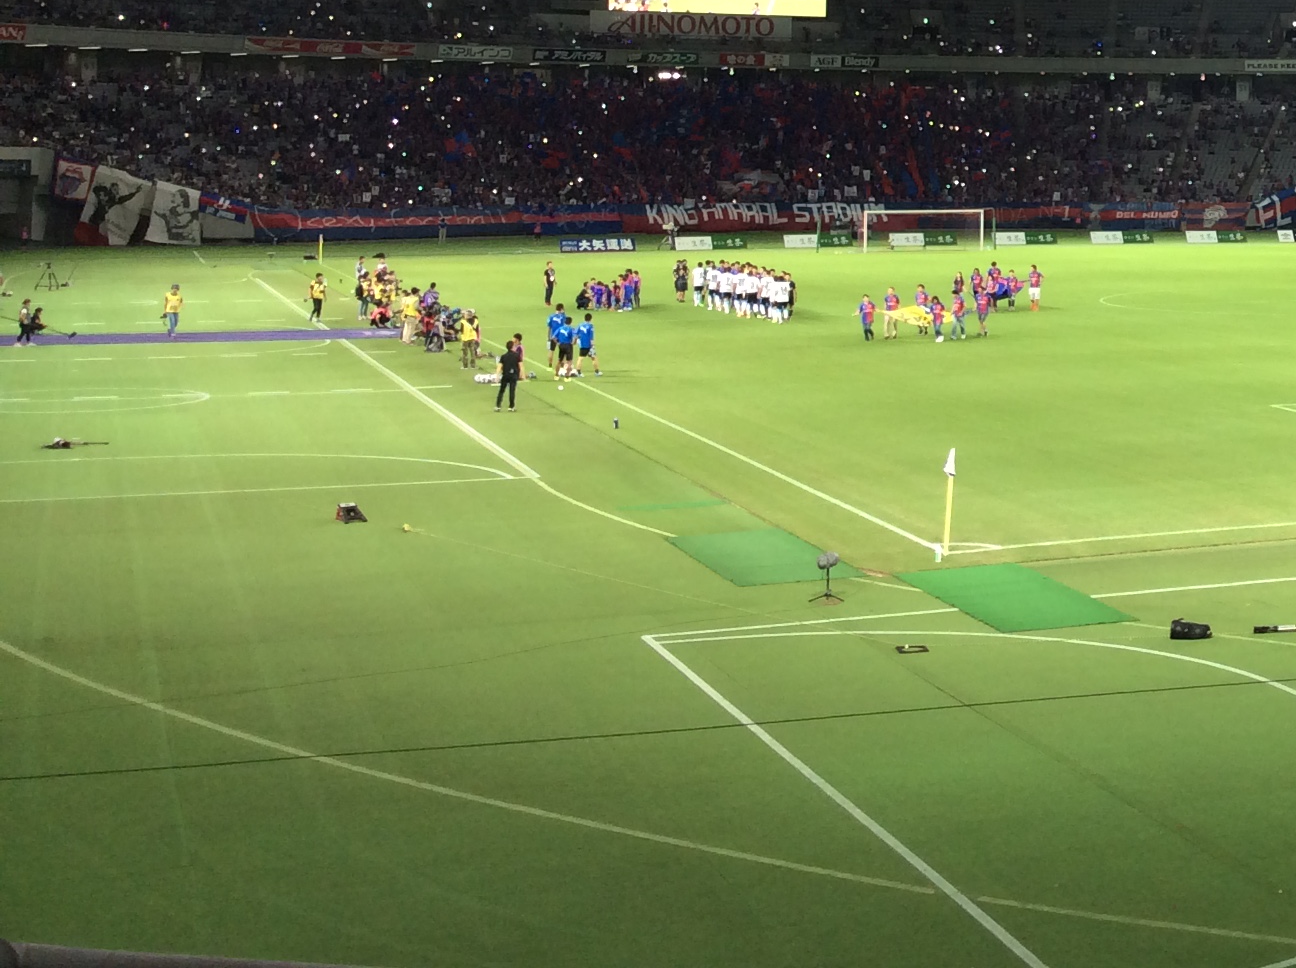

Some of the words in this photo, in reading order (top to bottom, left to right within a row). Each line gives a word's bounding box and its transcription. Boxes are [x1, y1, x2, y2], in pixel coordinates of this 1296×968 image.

[453, 46, 511, 58] アルインコ
[645, 204, 698, 225] KING
